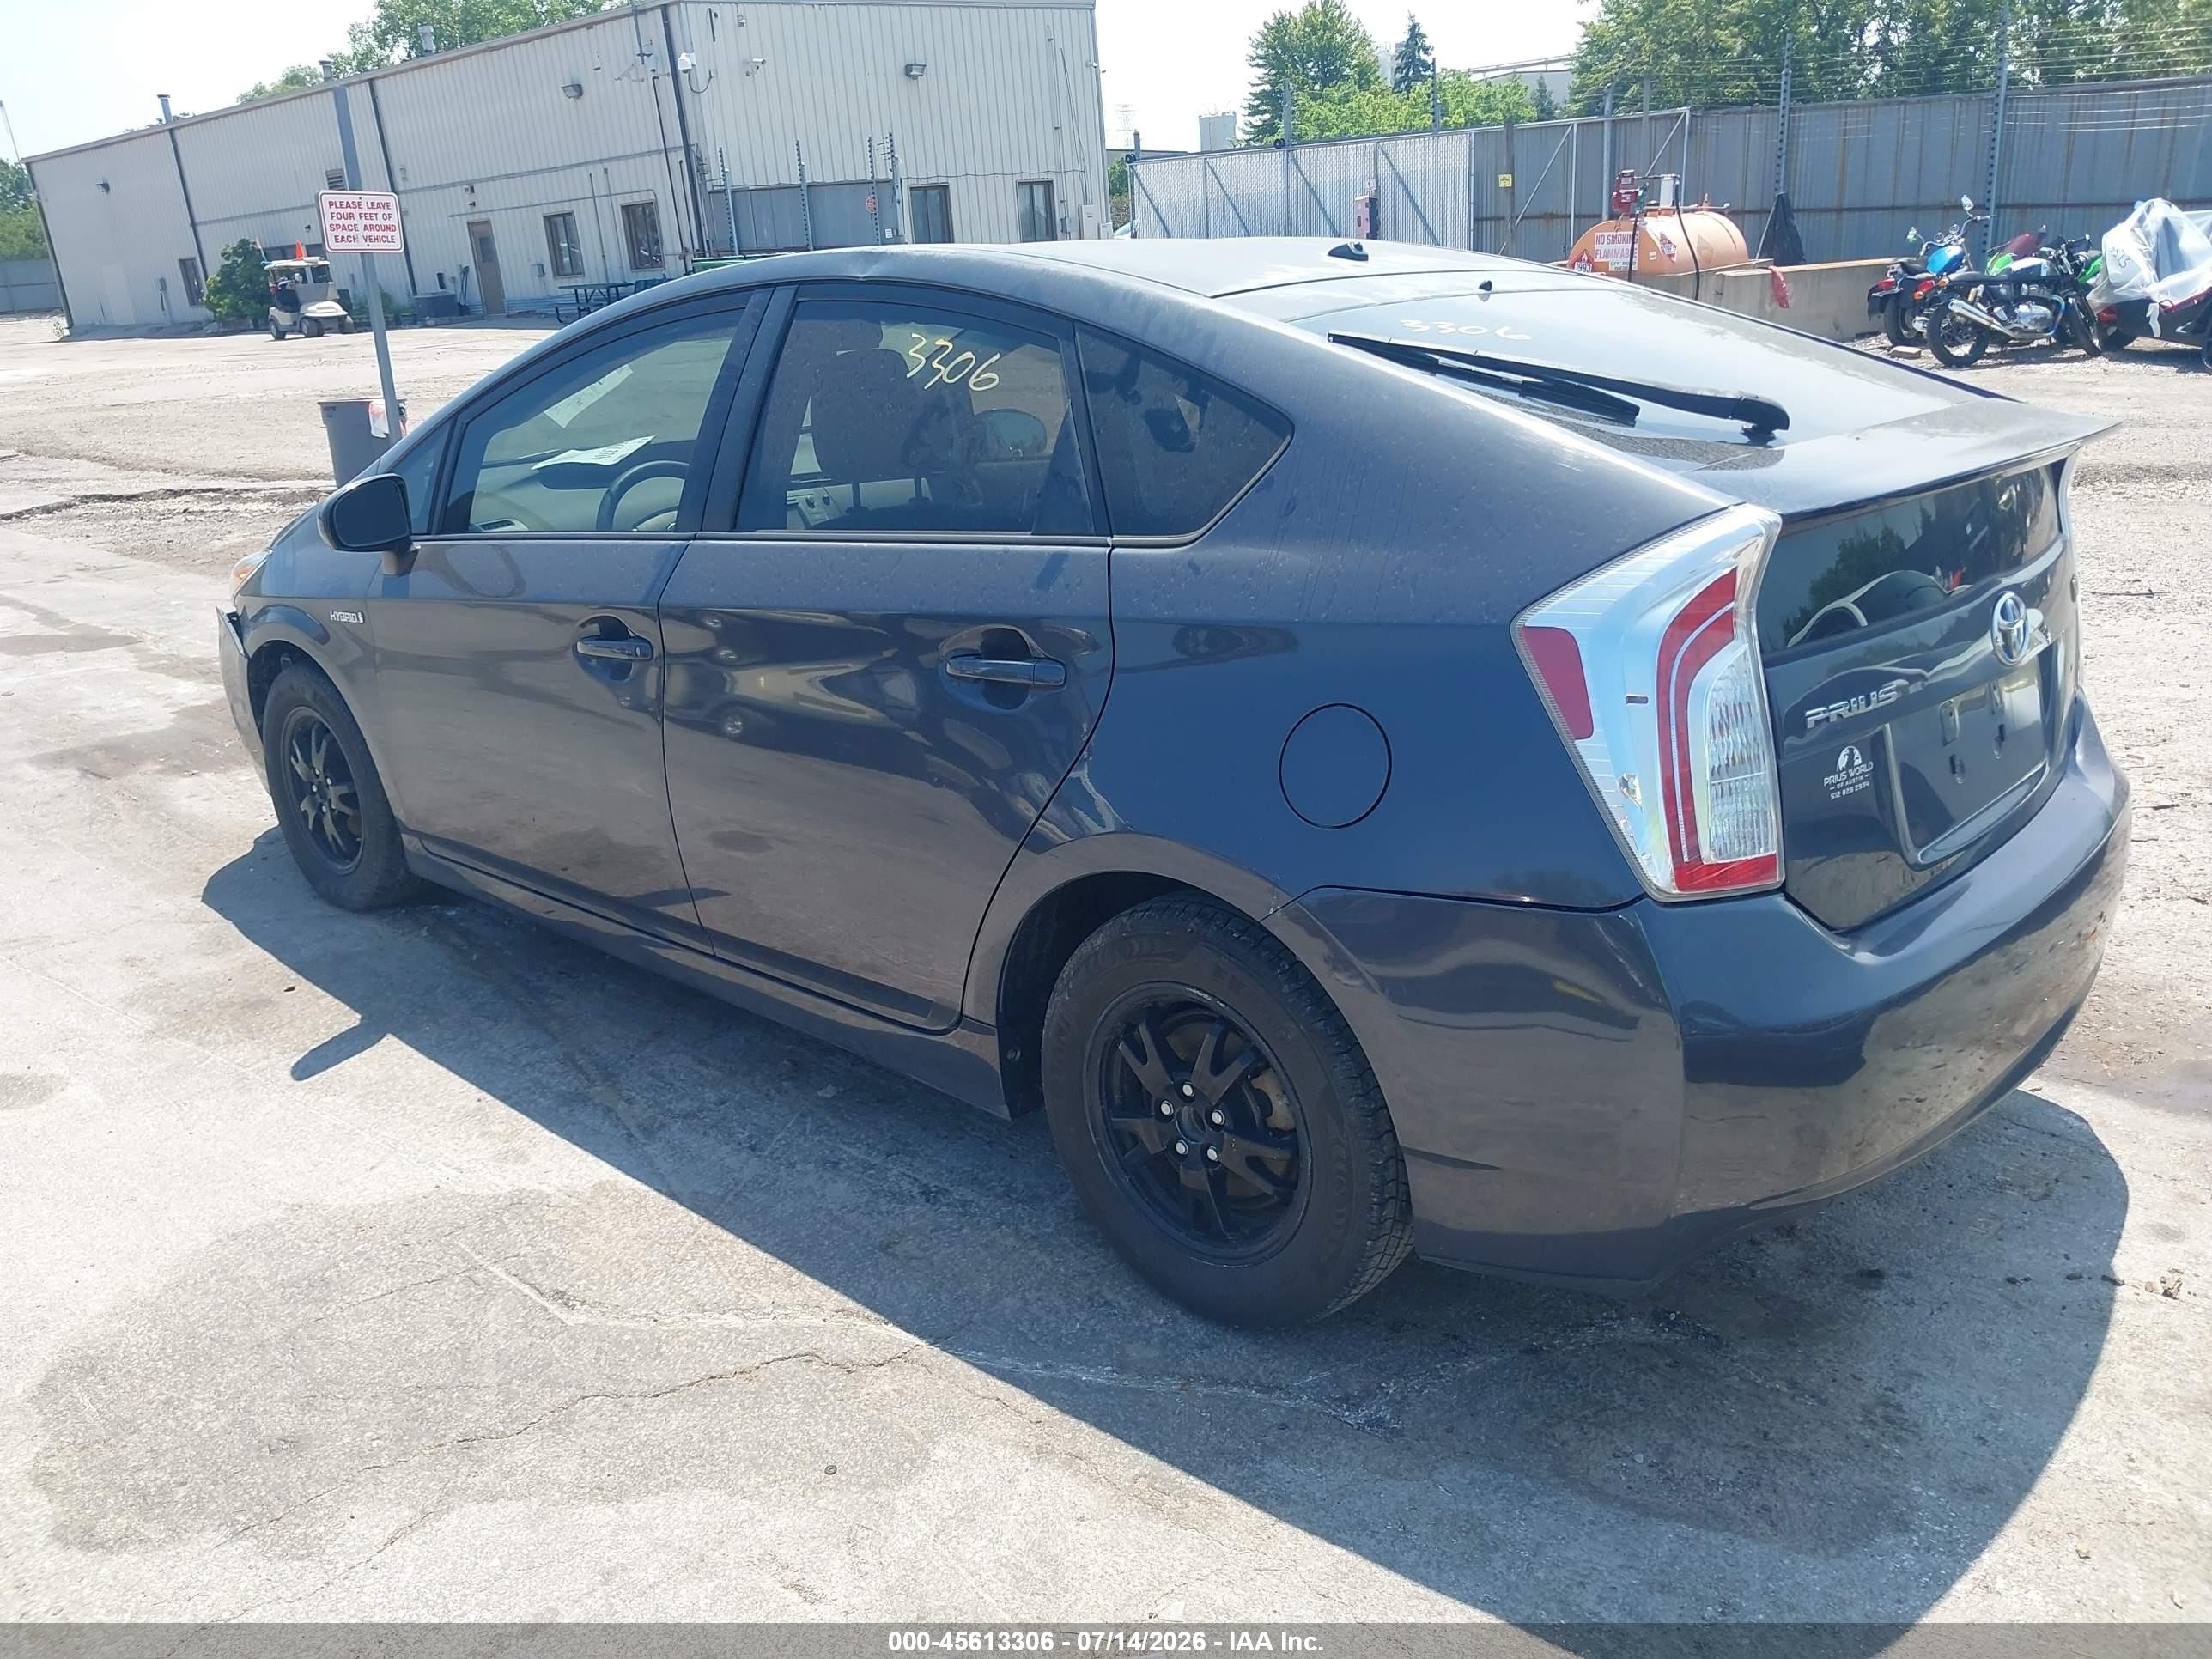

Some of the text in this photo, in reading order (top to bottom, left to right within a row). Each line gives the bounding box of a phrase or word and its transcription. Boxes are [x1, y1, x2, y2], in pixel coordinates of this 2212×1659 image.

[329, 201, 362, 210] PLEASE
[330, 223, 359, 232] SPACE
[362, 235, 396, 244] VEHICLE
[1595, 234, 1606, 246] NO
[1576, 263, 1591, 273] 1993
[1401, 319, 1533, 340] 3306
[906, 332, 1000, 392] 3306
[330, 611, 358, 623] HYBRID
[1805, 681, 1905, 729] PRIUS
[1823, 761, 1874, 787] PRIUS WORLD
